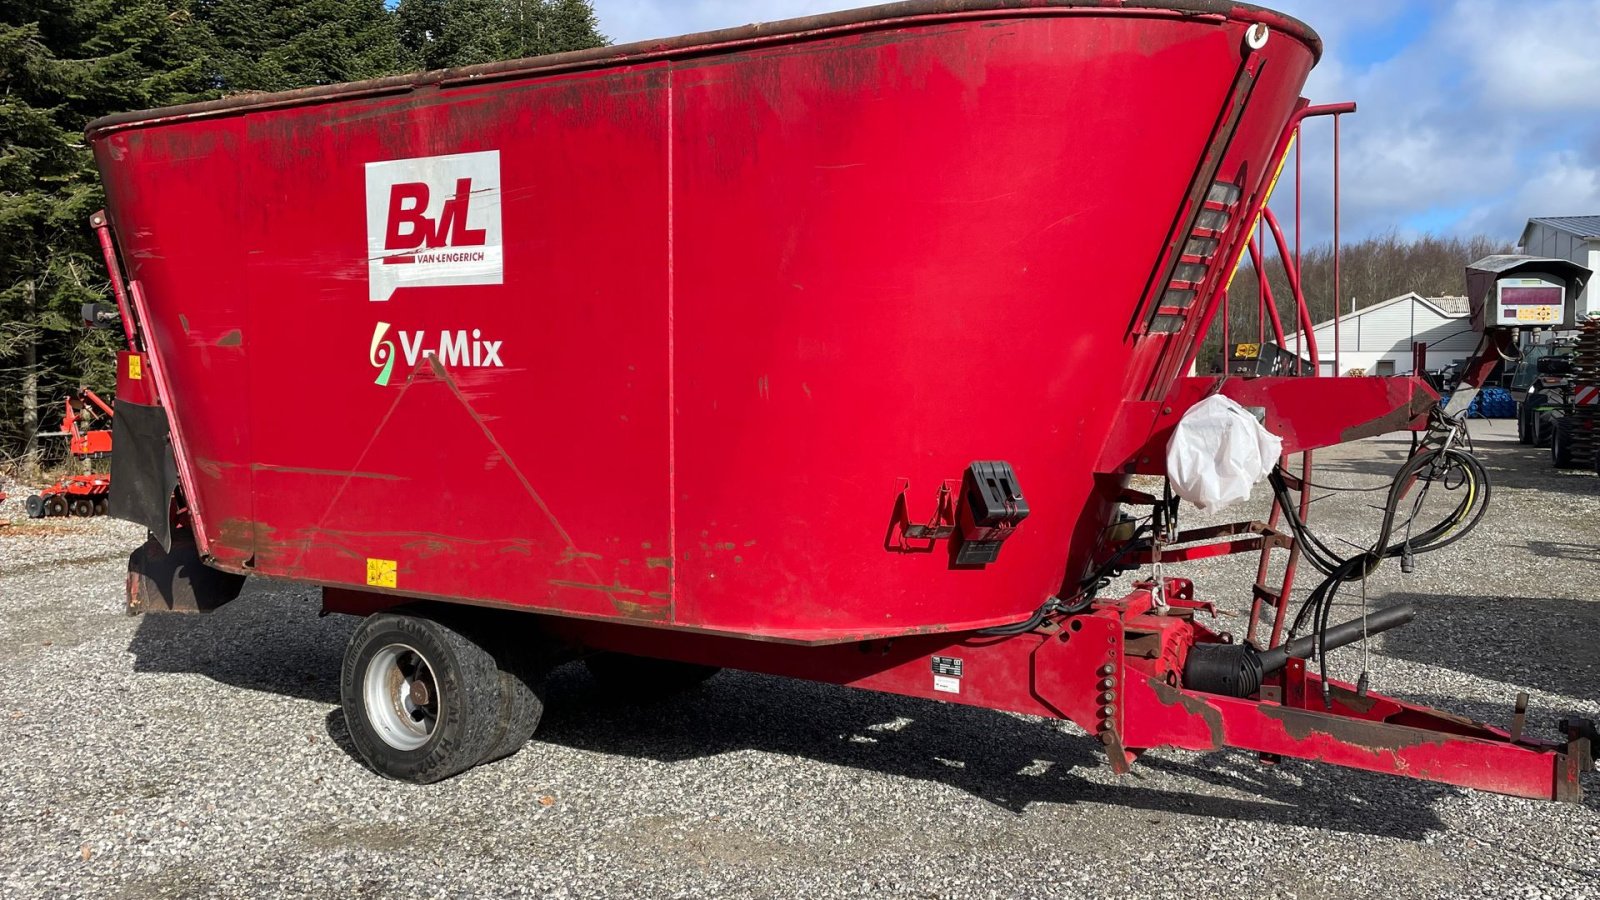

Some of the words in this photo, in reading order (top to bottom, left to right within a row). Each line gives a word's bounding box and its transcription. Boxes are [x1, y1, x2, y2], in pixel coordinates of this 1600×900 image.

[384, 178, 487, 250] BvL
[417, 254, 435, 264] VAN
[437, 252, 485, 263] LENGERICH
[398, 329, 504, 367] V-Mix
